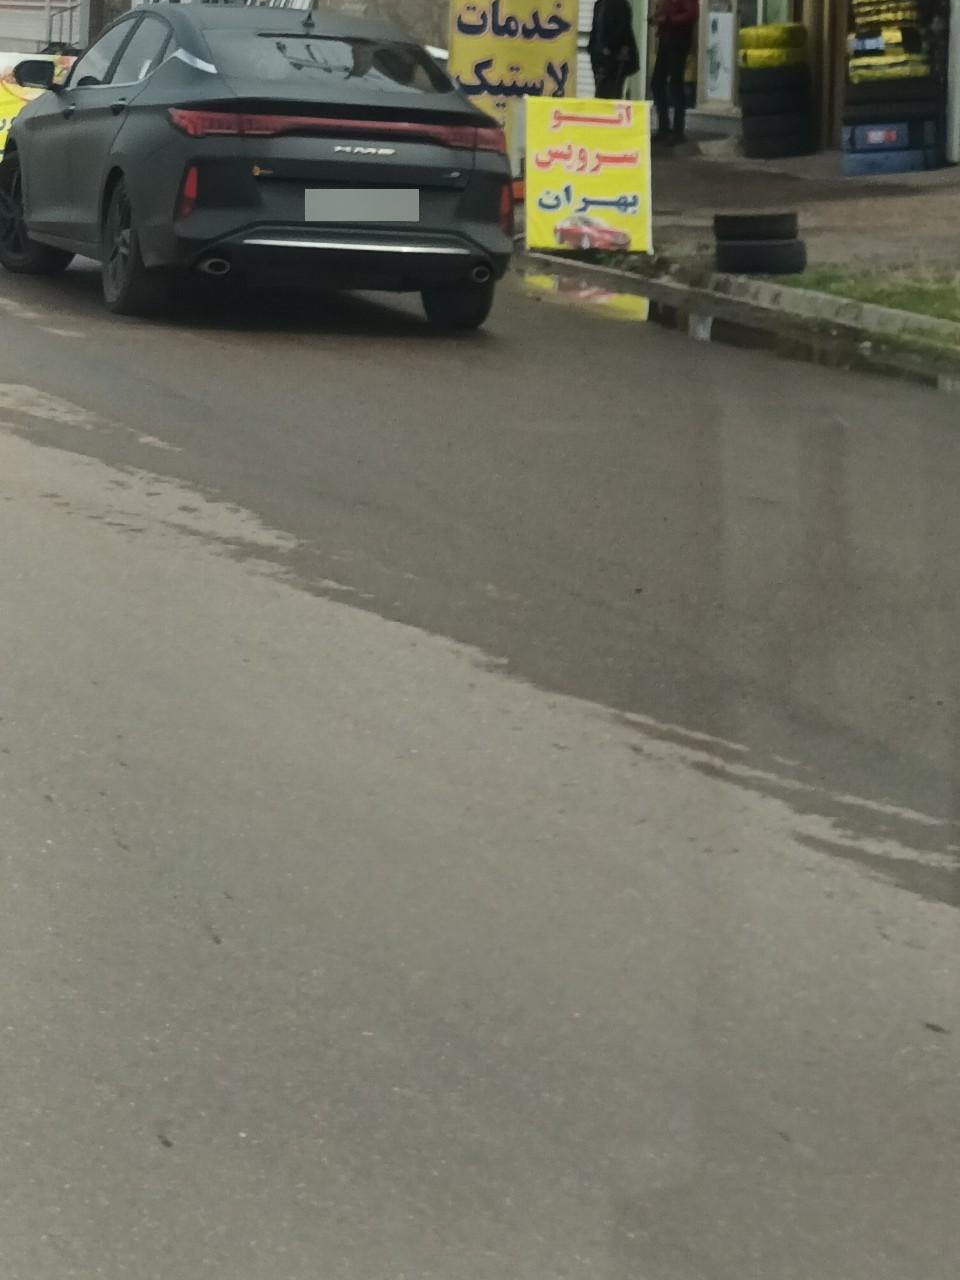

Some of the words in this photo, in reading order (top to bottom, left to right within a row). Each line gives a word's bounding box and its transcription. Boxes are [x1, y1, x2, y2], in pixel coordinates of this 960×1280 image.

[455, 58, 570, 108] لاستیک
[552, 104, 632, 128] اتو
[535, 144, 640, 173] سرویس
[537, 185, 640, 214] بهران
